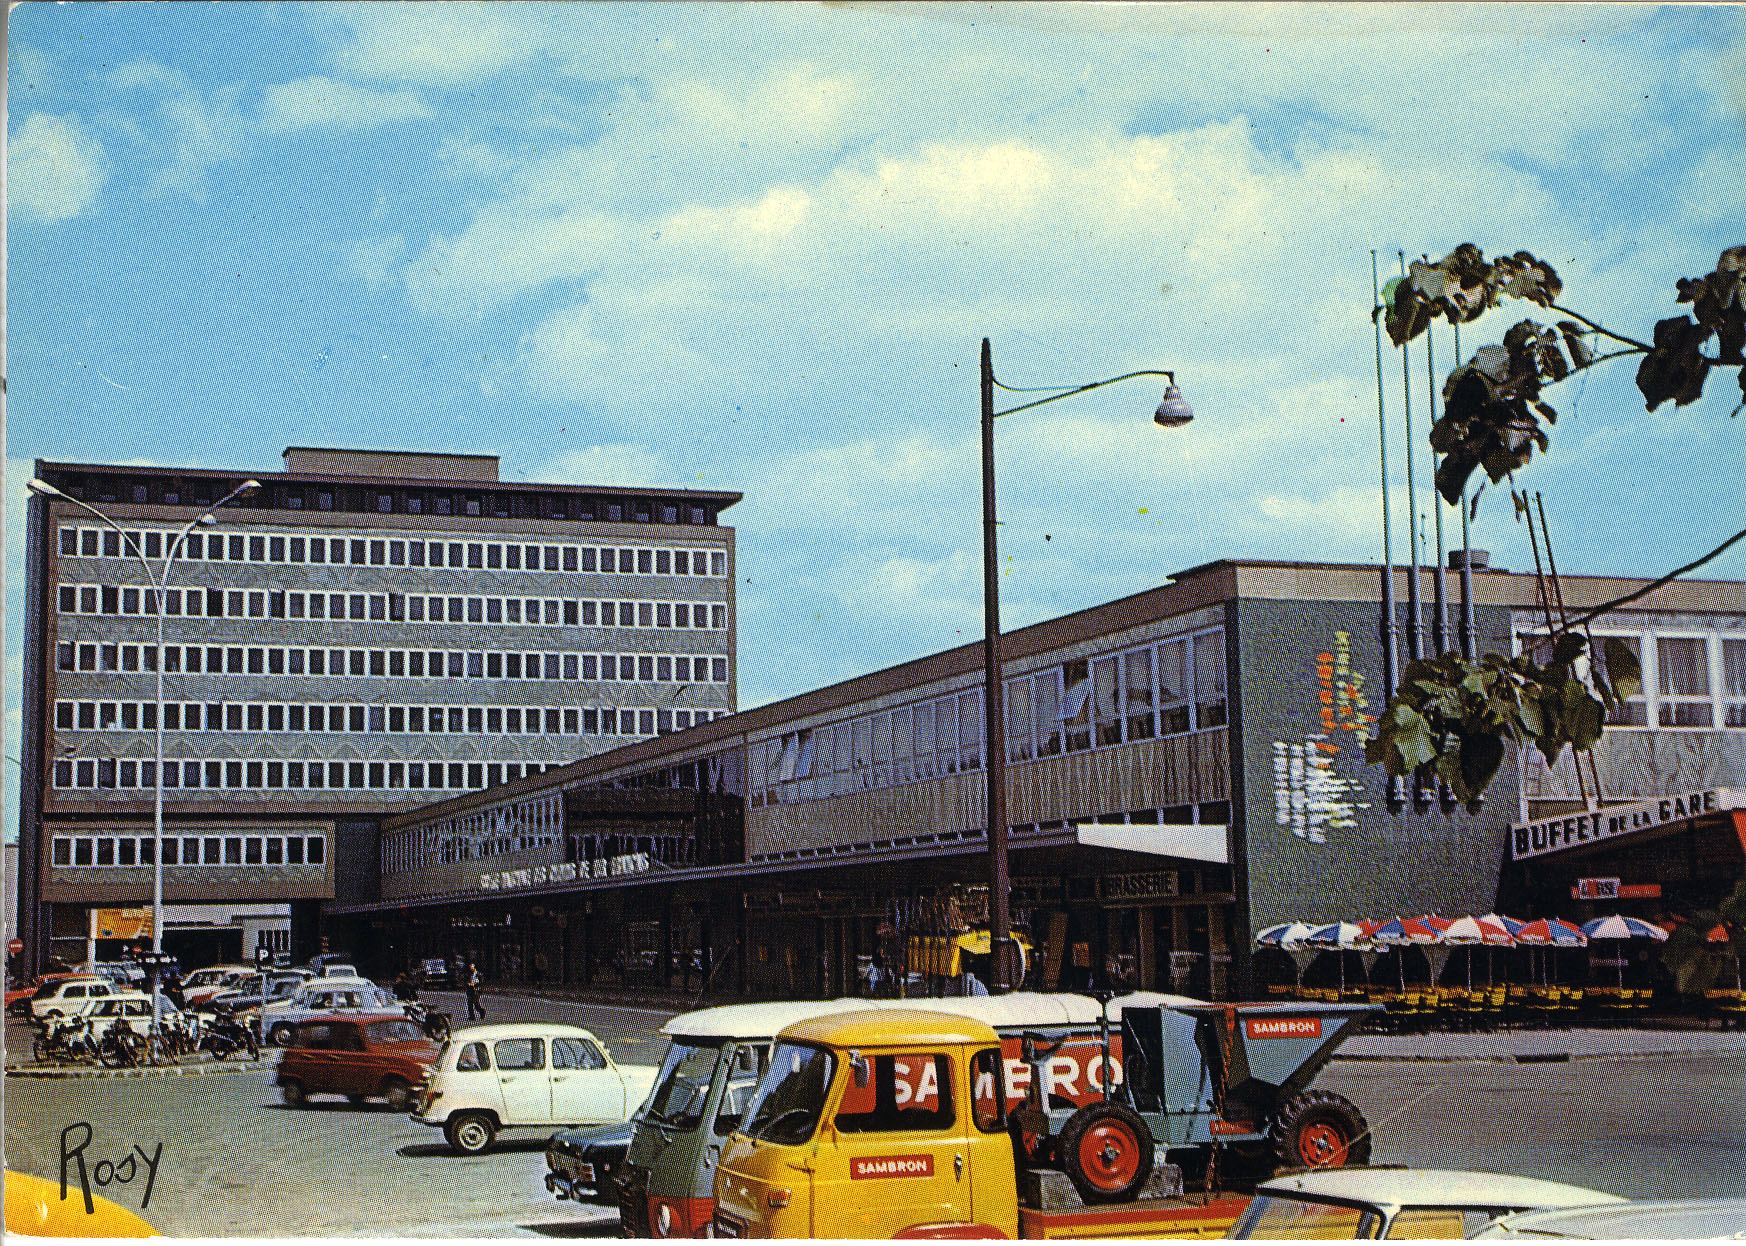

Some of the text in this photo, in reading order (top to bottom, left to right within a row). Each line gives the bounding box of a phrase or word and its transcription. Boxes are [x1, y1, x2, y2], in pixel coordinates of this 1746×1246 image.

[1514, 790, 1716, 855] BUFFET DE LA GARE
[1106, 872, 1173, 896] BRASSERIE
[258, 948, 270, 962] P
[1253, 1020, 1316, 1035] SAMBRON
[856, 1159, 928, 1177] SAMBRON
